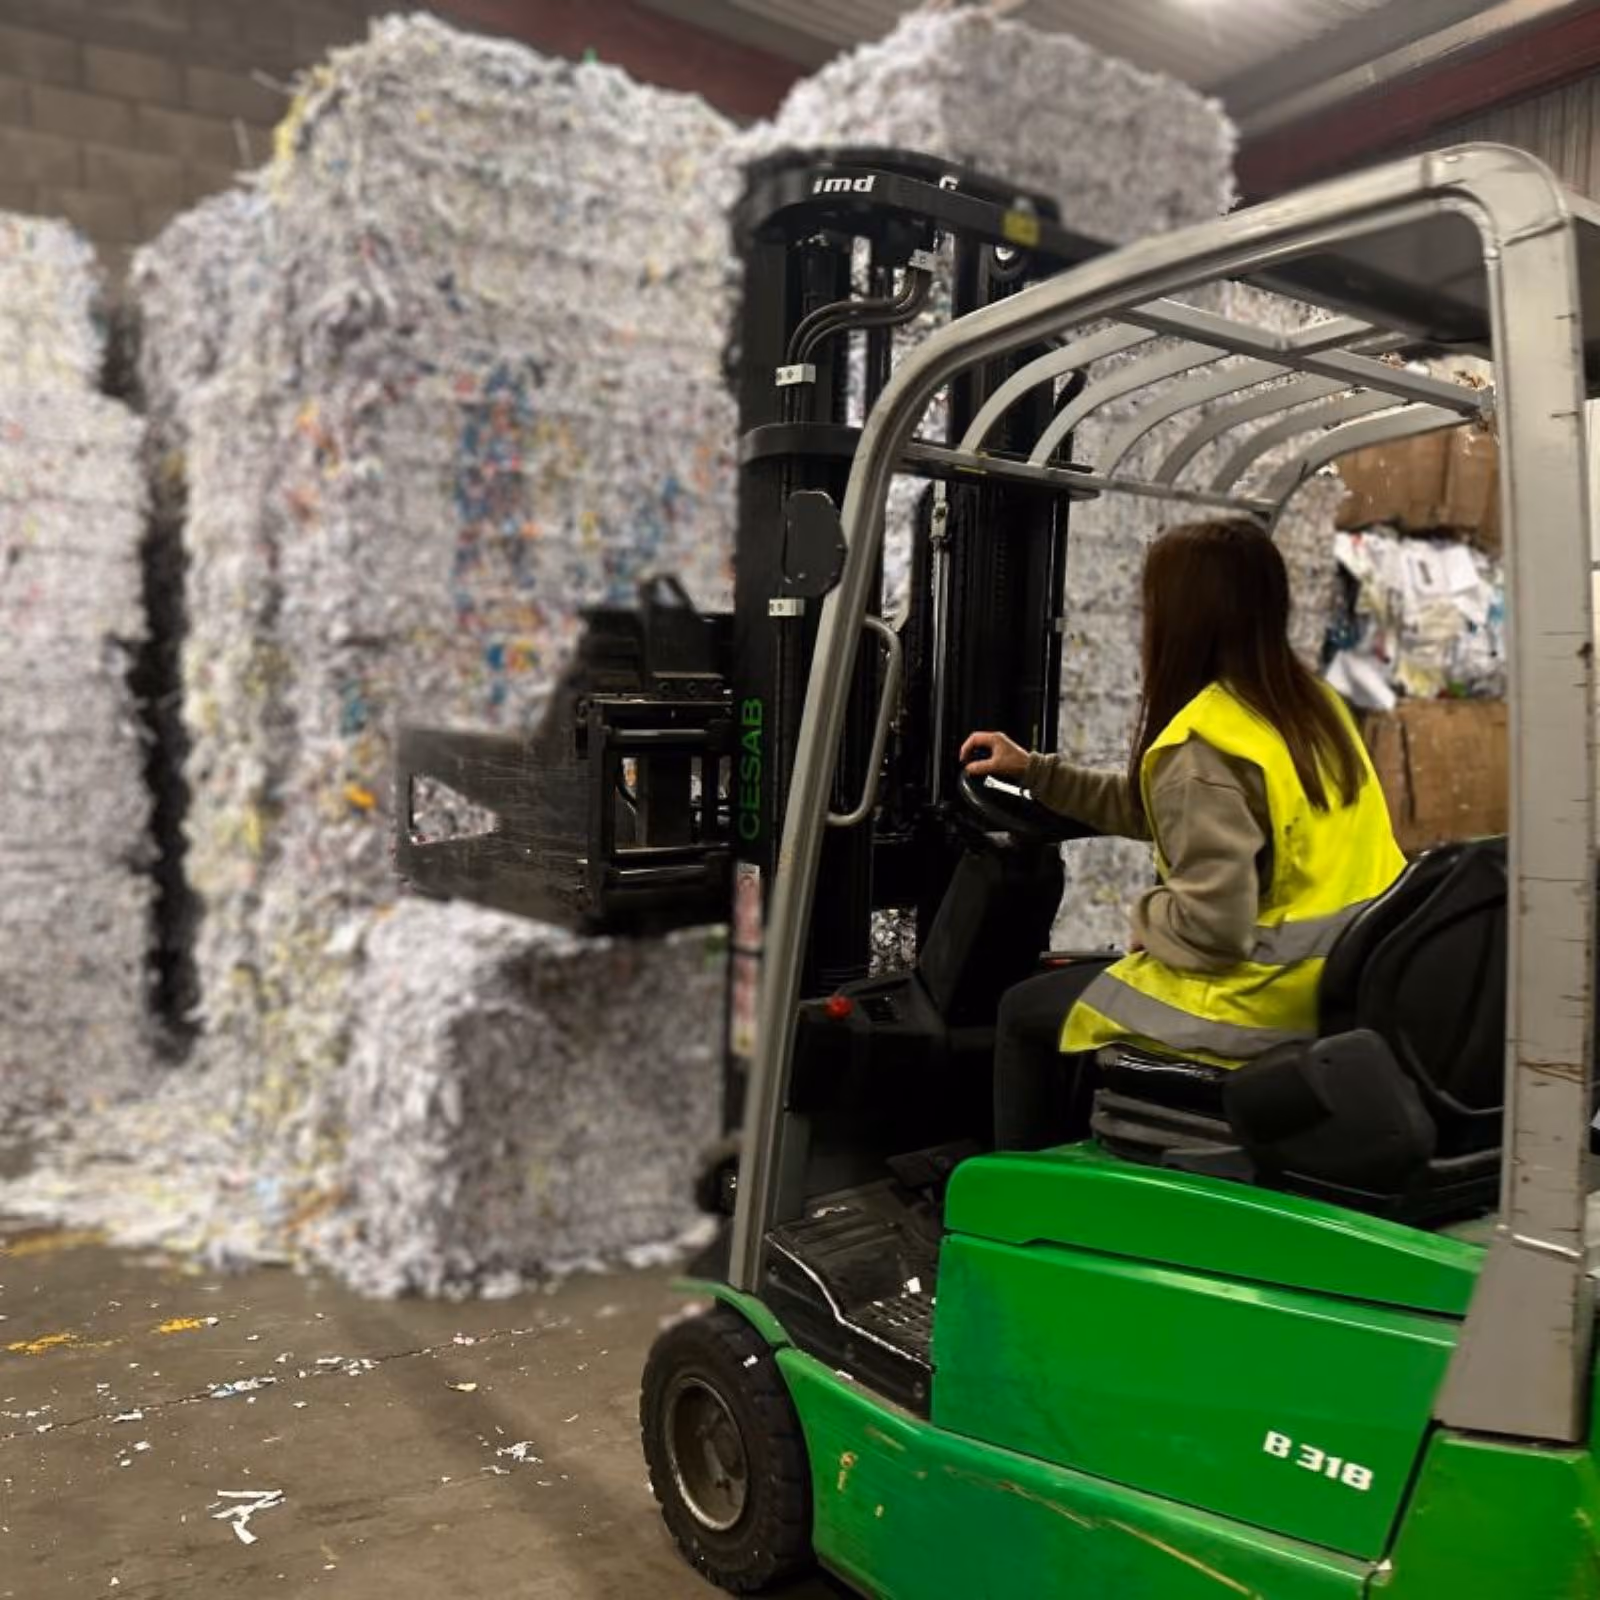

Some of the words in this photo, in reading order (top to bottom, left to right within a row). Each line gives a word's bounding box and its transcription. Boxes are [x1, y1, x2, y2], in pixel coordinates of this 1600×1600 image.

[739, 698, 763, 840] CESAB
[1263, 1430, 1292, 1458] B
[1295, 1443, 1374, 1491] 318
